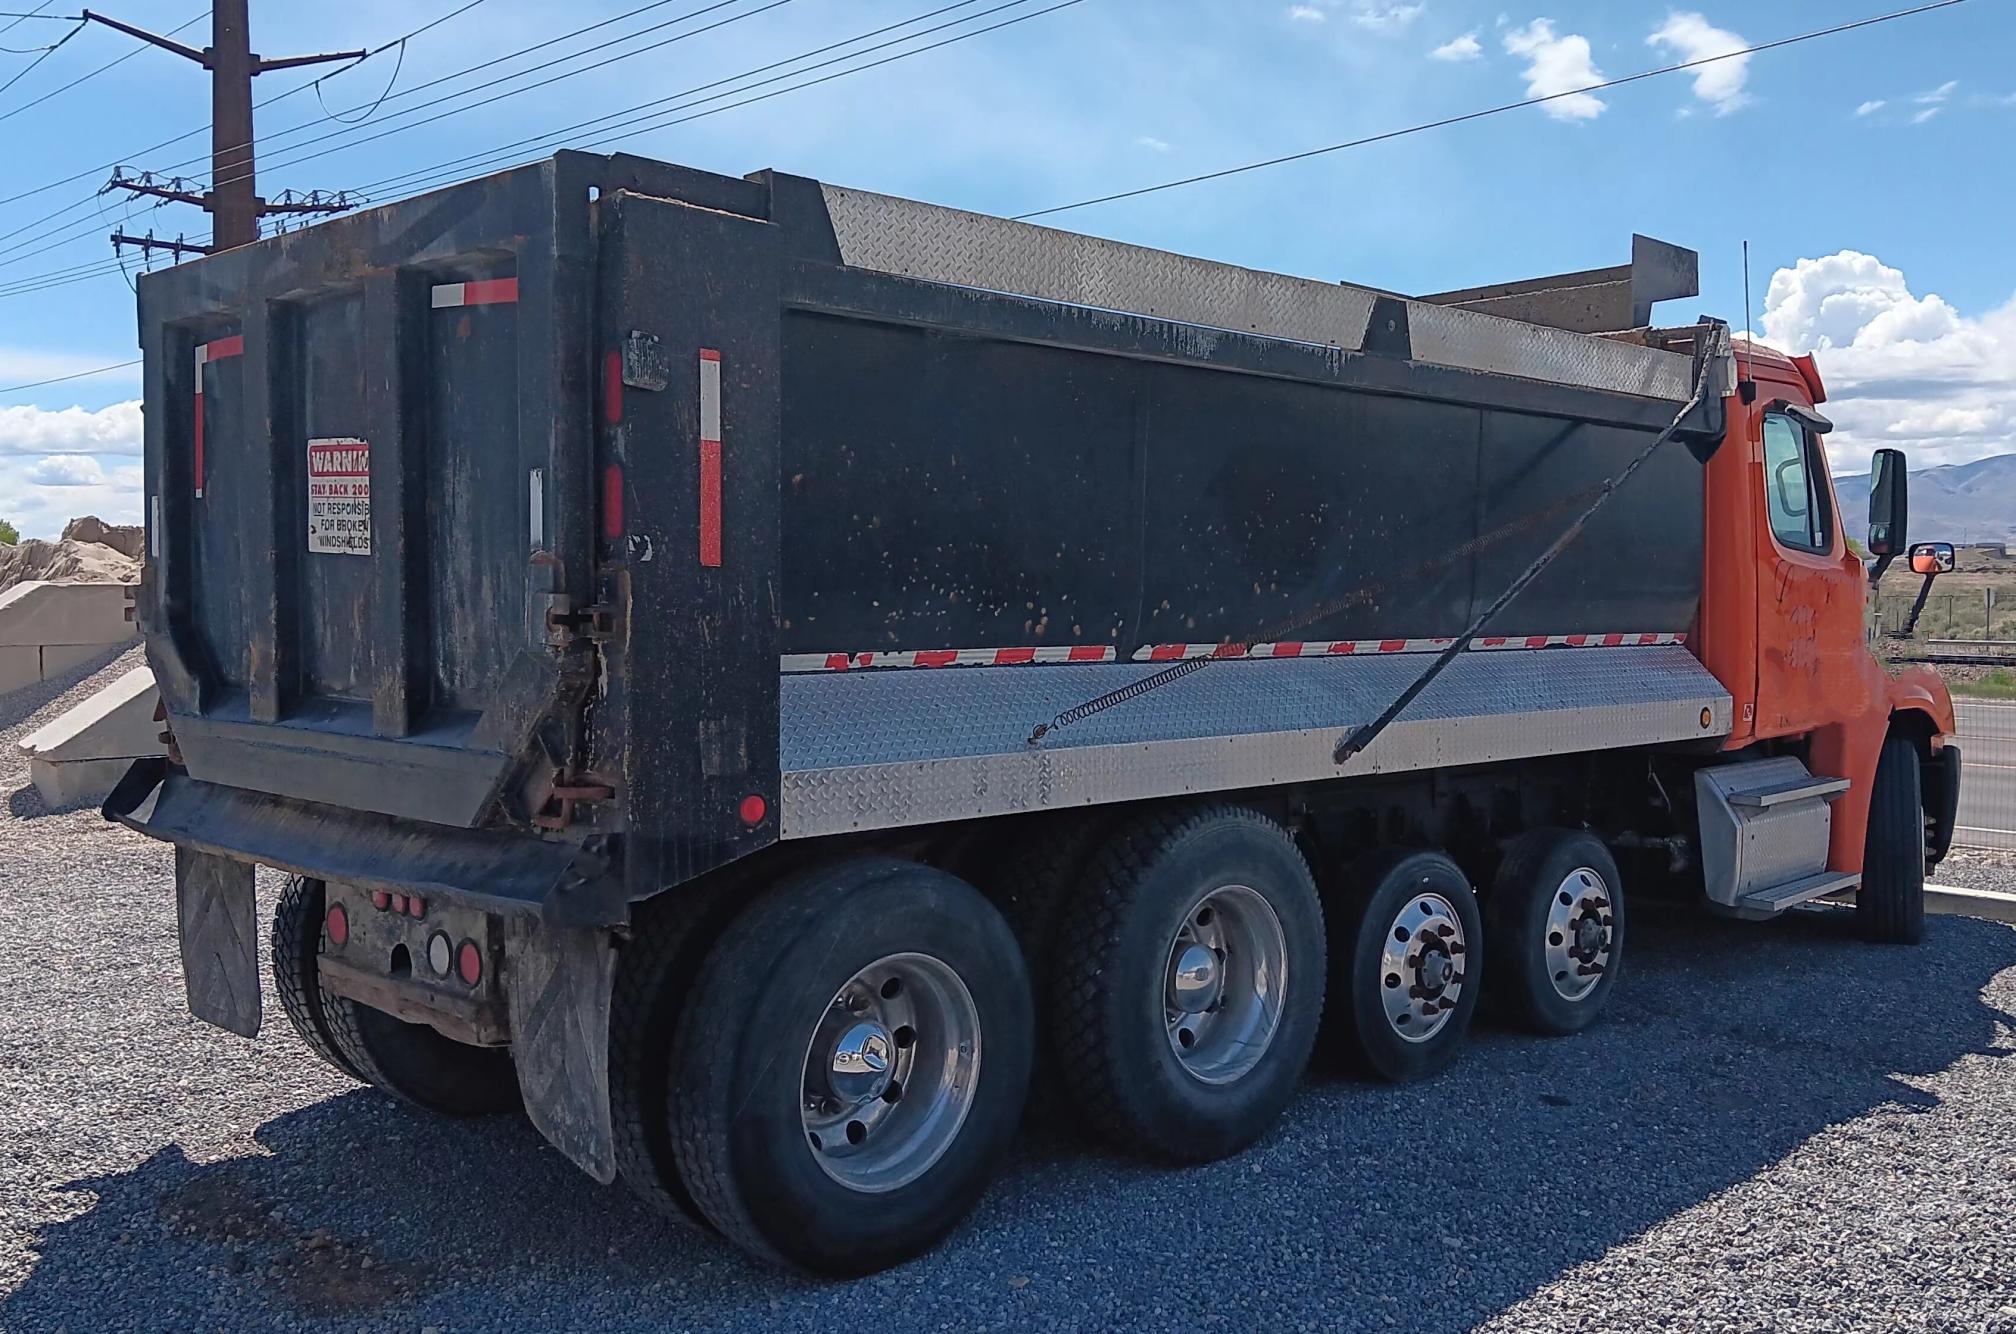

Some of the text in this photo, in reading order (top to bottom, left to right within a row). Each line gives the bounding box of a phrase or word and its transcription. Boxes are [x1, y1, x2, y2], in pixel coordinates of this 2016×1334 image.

[311, 484, 369, 496] STAY BACK 200
[313, 503, 325, 514] NOT
[321, 519, 369, 532] FOR BROKEN
